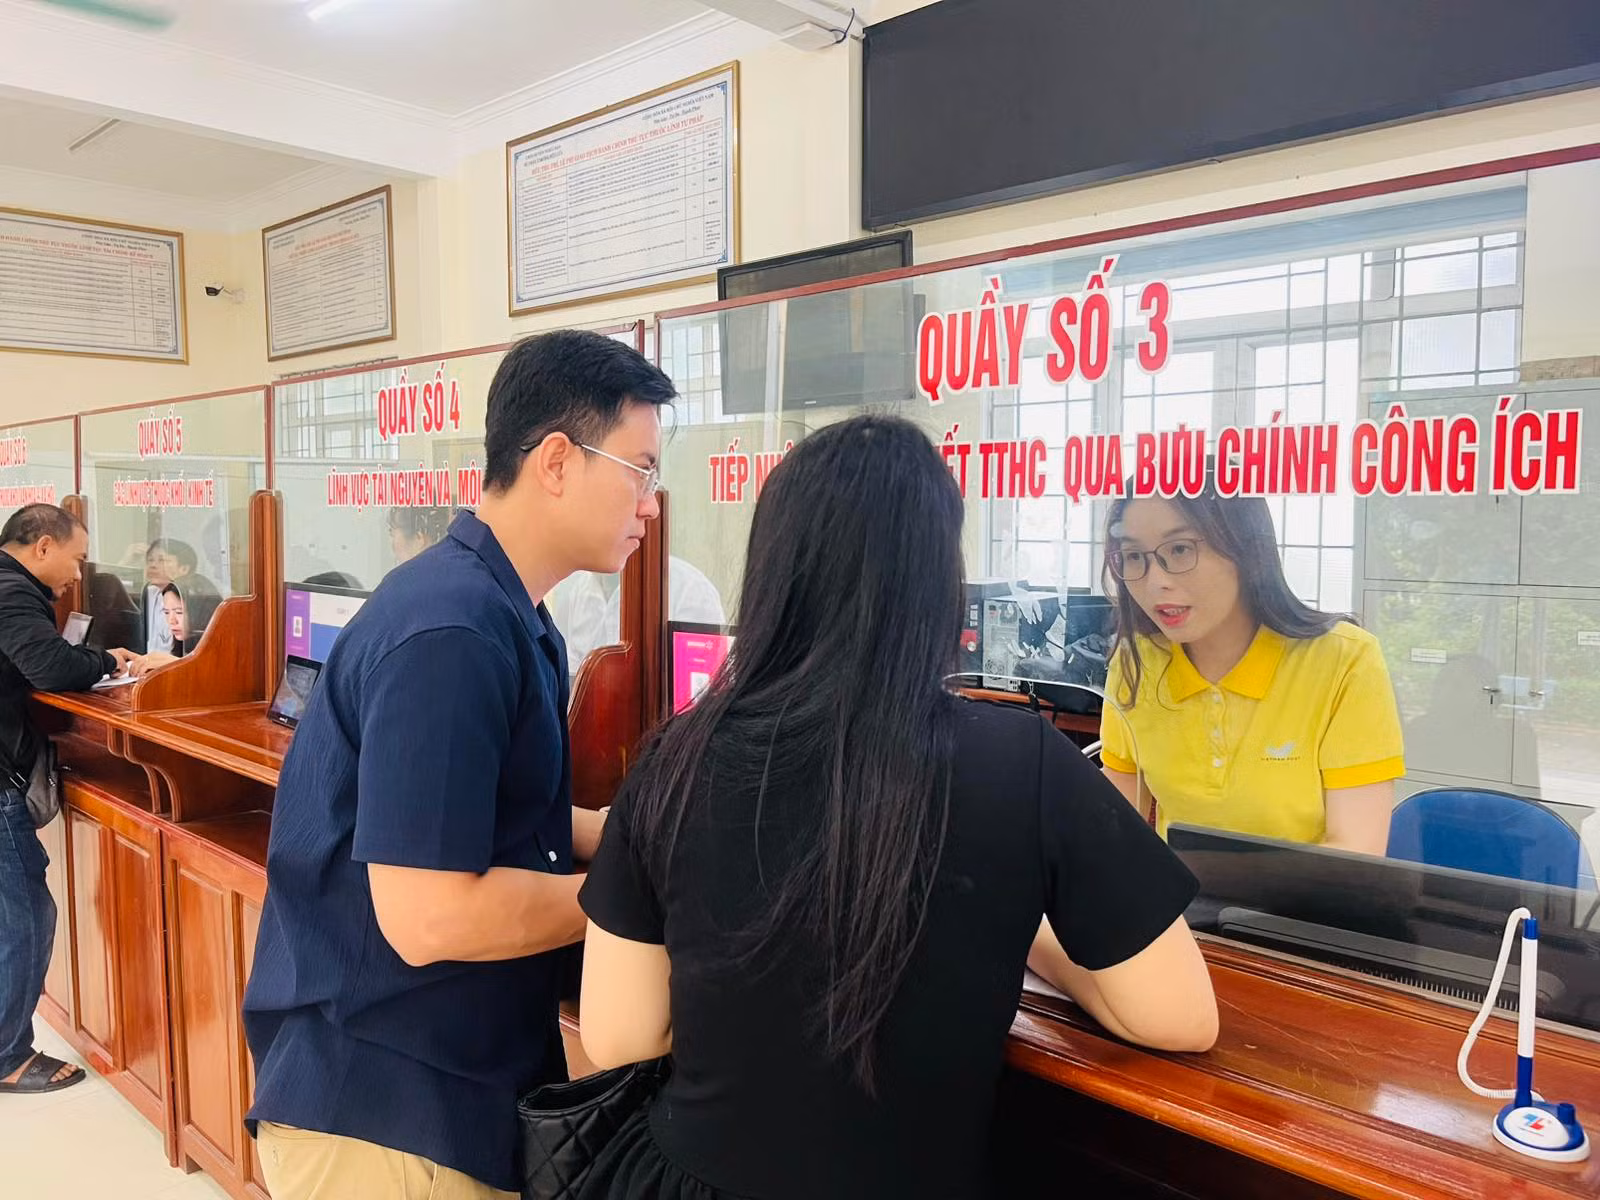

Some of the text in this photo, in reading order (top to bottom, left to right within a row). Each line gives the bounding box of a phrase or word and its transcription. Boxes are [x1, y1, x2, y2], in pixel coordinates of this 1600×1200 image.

[918, 257, 1170, 403] QUẦY SỐ 3
[176, 416, 183, 454] 5
[378, 362, 461, 440] QUẦY SỐ 4
[372, 464, 388, 506] TÀI
[390, 463, 434, 506] NGUYÊN
[436, 462, 452, 506] VÀ
[709, 438, 750, 503] TIẾP
[980, 440, 1047, 498] TTHC
[1064, 434, 1124, 504] QUA
[1135, 425, 1205, 496] BƯU
[1217, 410, 1339, 495] CHÍNH
[1351, 405, 1477, 494] CÔNG
[1493, 396, 1579, 491] ÍCH
